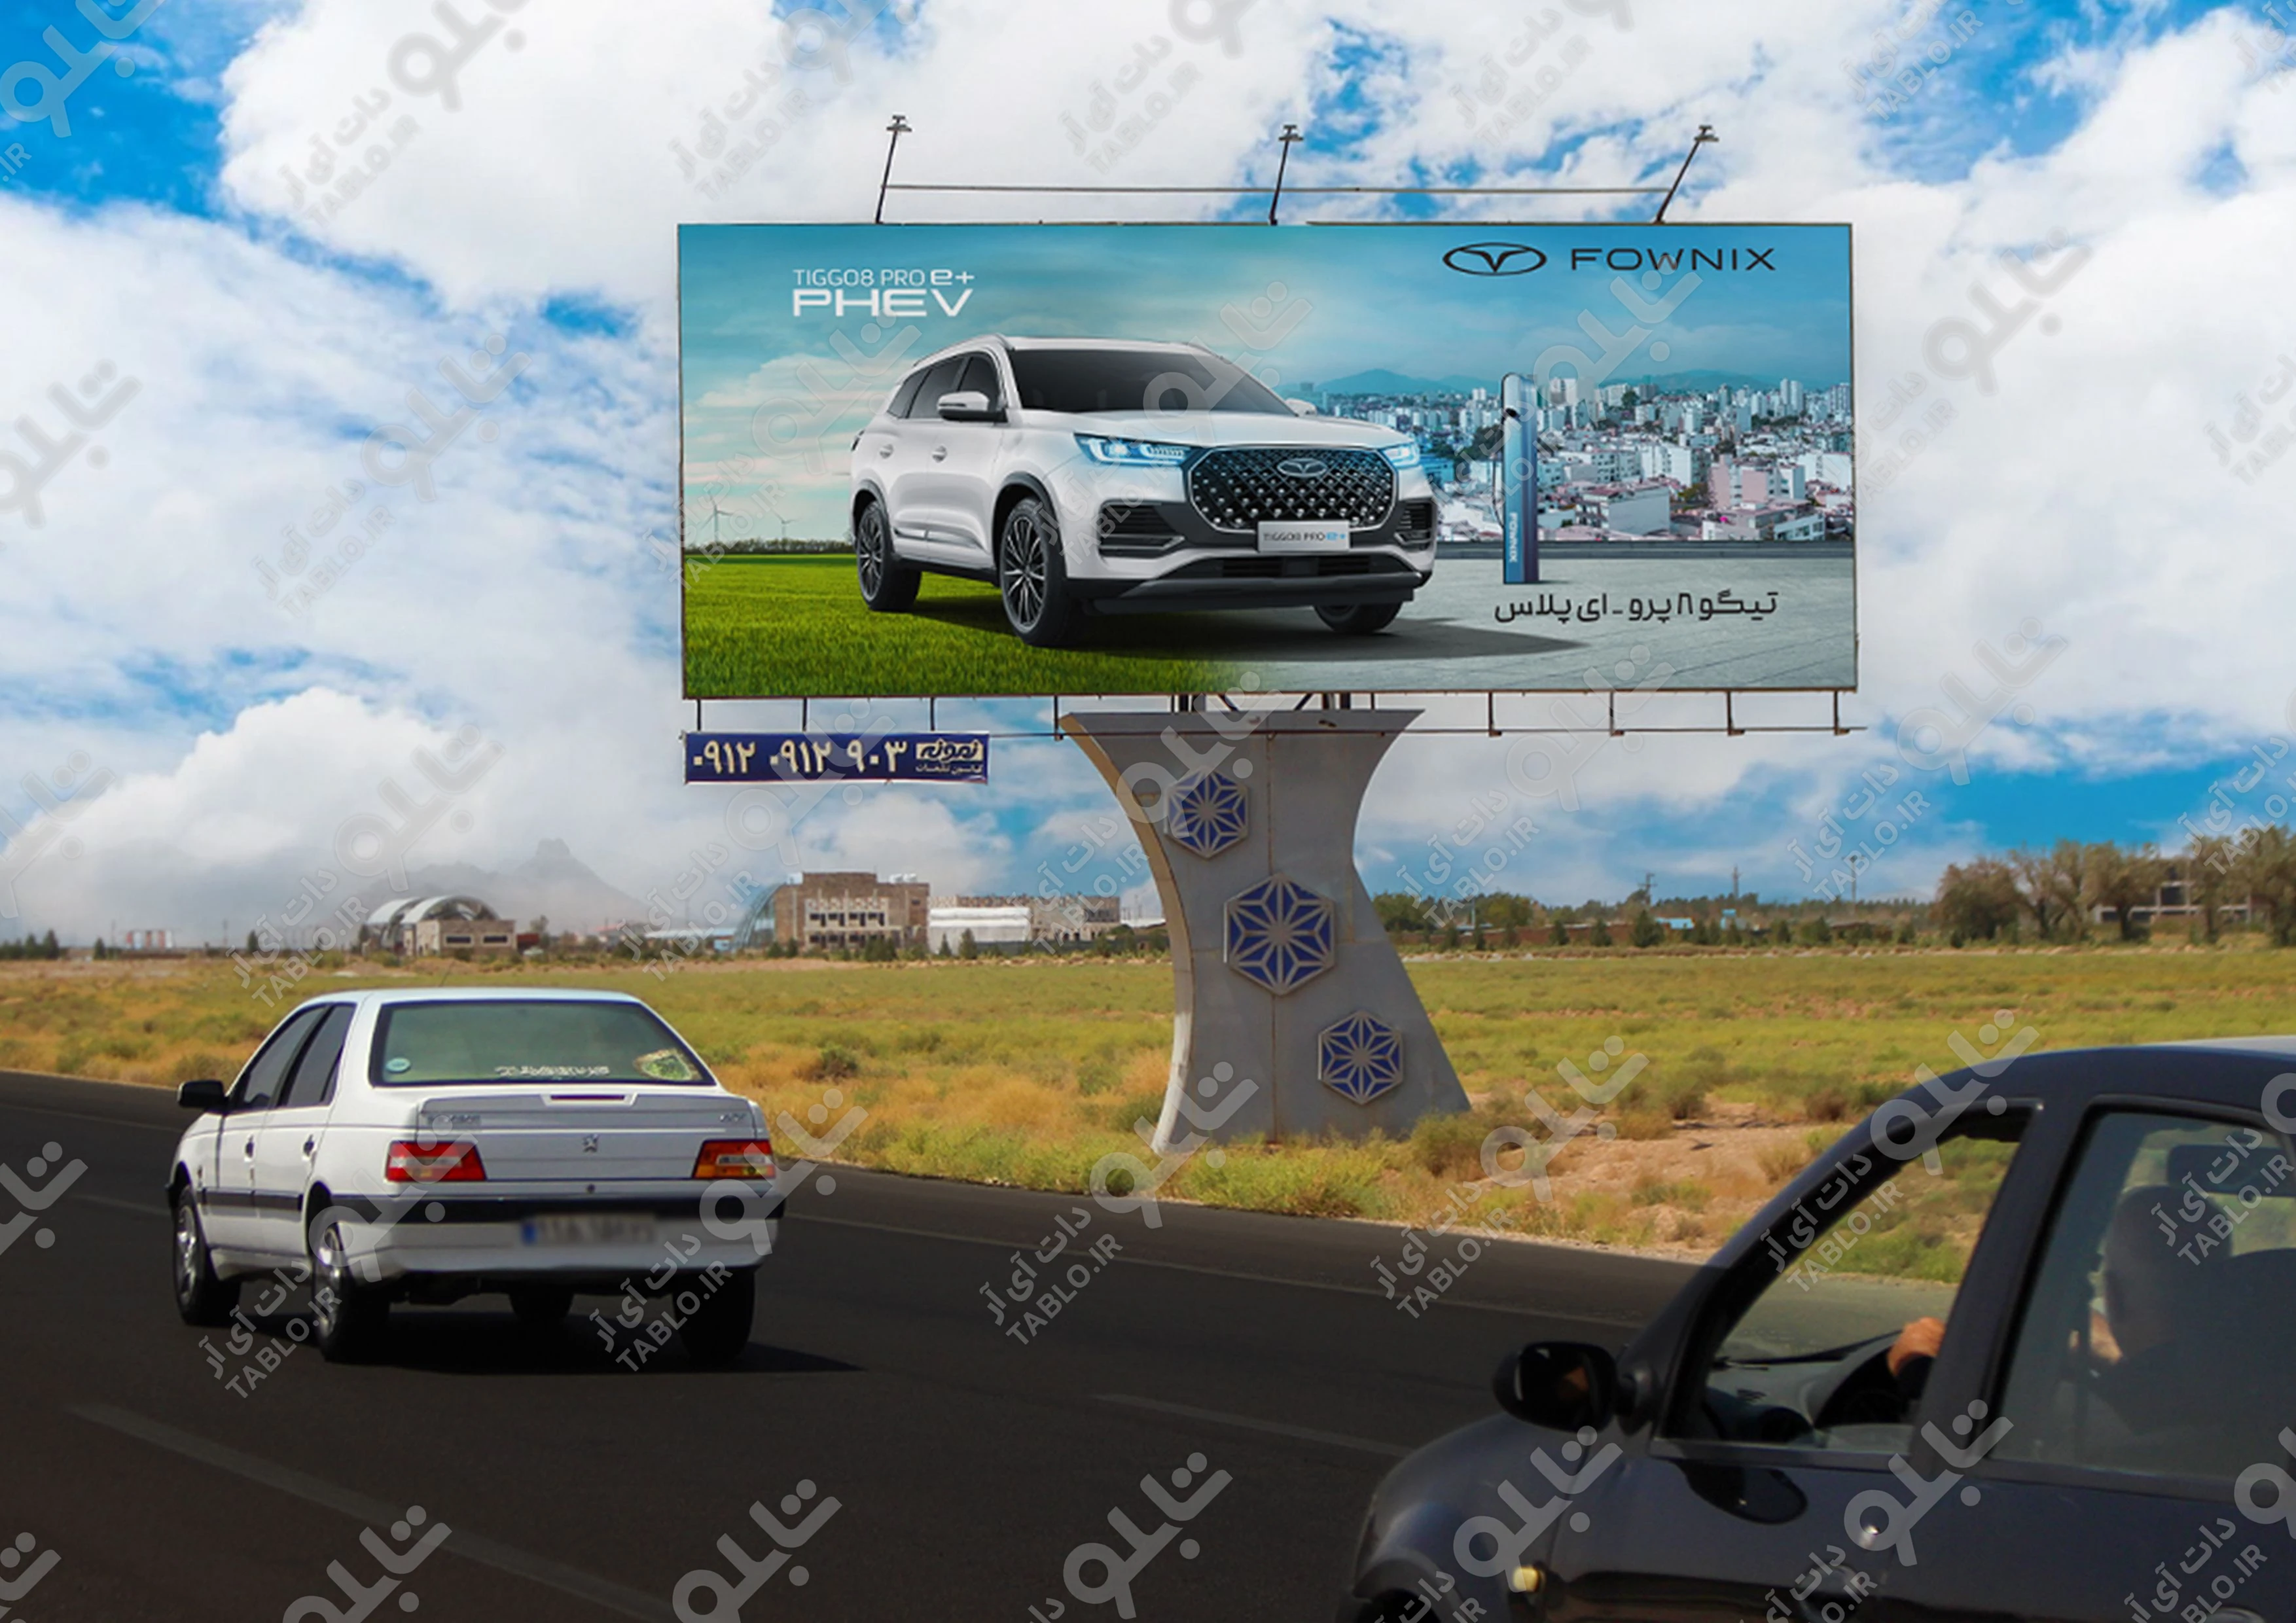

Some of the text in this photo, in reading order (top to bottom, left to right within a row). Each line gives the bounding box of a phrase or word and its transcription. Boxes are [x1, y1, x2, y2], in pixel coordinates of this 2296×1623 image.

[1571, 248, 1776, 271] FOWNIX
[793, 269, 975, 287] TIGGO8 PRO e+
[793, 289, 973, 317] PHEV
[1494, 594, 1571, 624] پلاس
[1577, 593, 1607, 622] ای
[1628, 597, 1672, 624] پرو
[1698, 590, 1778, 620] تیگو
